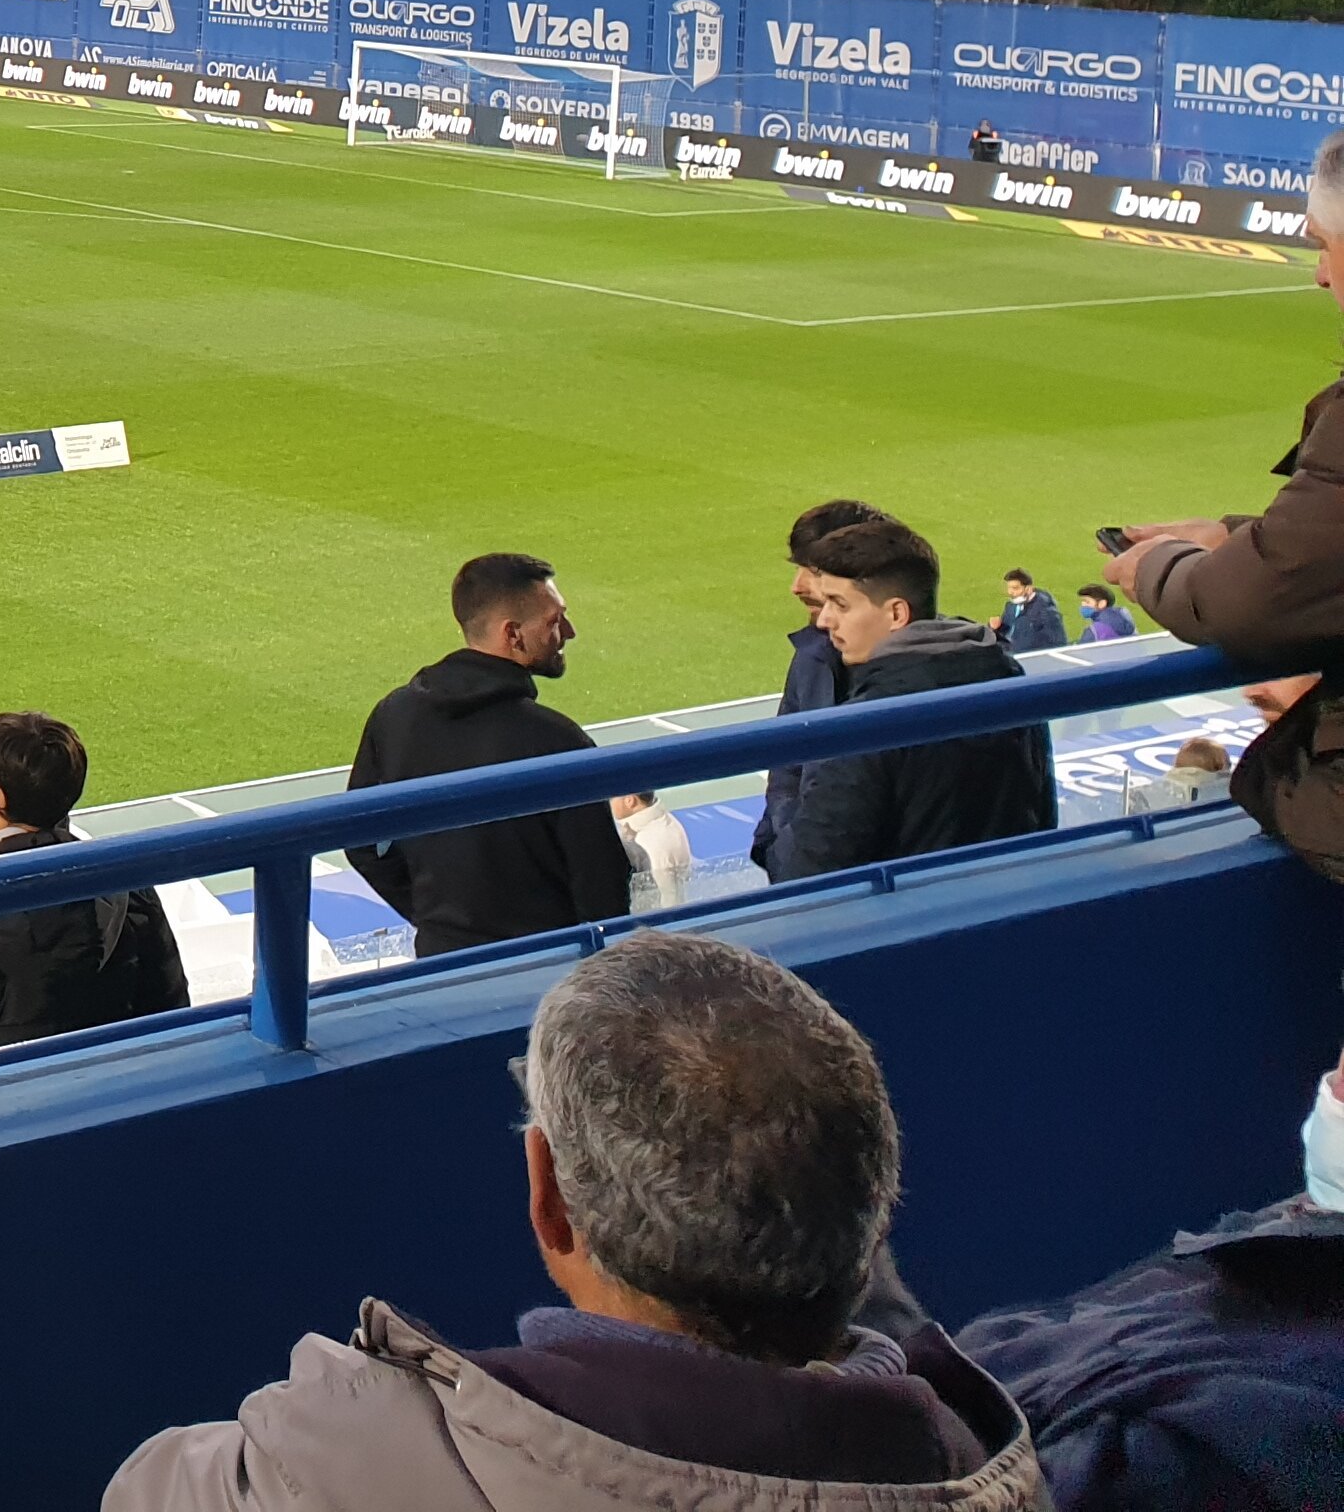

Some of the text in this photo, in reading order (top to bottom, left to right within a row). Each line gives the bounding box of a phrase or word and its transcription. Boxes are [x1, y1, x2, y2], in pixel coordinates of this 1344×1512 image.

[350, 22, 473, 44] TRANSPORT & LOGISTICS
[508, 2, 630, 52] Vizela
[515, 46, 628, 64] SEGREDOS DE UM VALE
[766, 20, 911, 76] Vizela
[2, 58, 44, 83] bwin
[63, 65, 108, 91] bwin
[775, 69, 910, 90] SEGREDOS DE UM VALE
[1174, 62, 1344, 106] FINICON
[128, 72, 173, 99] bwin
[194, 80, 241, 108] bwin
[954, 72, 1138, 102] TRANSPORT & LOGISTICS
[264, 88, 314, 116] bwin
[204, 114, 260, 130] bwin
[418, 106, 472, 134] bwin
[670, 112, 714, 132] 1939
[1301, 111, 1319, 122] DE
[500, 116, 558, 146] bwin
[676, 136, 742, 168] bwin
[775, 146, 845, 180] bwin
[880, 158, 955, 194] bwin
[1223, 162, 1266, 188] SÃO
[827, 192, 907, 213] bwin
[993, 172, 1073, 209] bwin
[1115, 186, 1202, 224] bwin
[1247, 201, 1309, 238] bw
